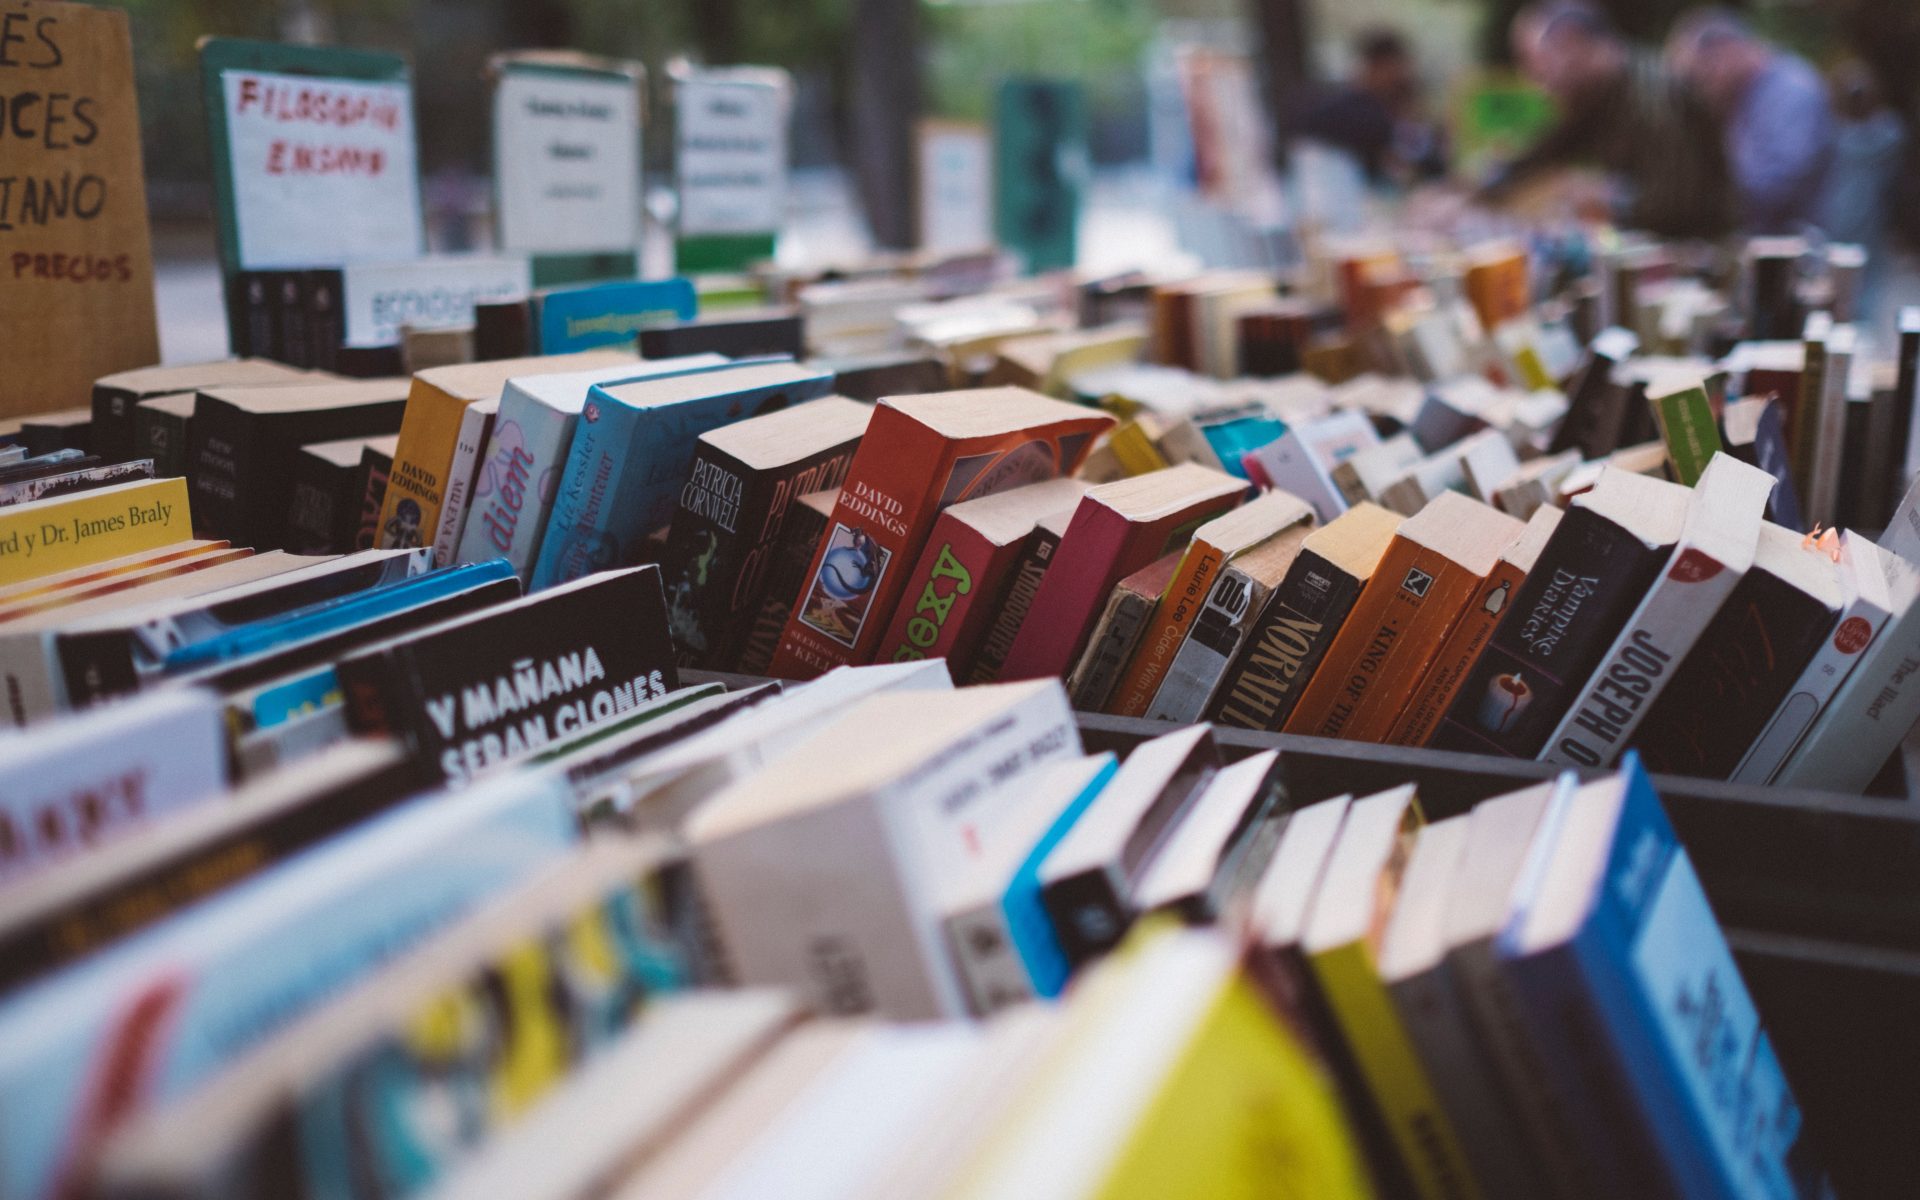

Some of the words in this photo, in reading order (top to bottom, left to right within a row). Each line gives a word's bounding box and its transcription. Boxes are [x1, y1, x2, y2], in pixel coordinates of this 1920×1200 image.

[0, 92, 99, 150] CES
[391, 471, 440, 505] EDDINGS
[402, 460, 437, 488] DAVID
[566, 432, 596, 501] Kessler
[691, 457, 743, 506] PATRICIA
[482, 446, 534, 552] diem
[681, 481, 740, 534] CORNWELL
[839, 490, 908, 537] EDDINGS
[855, 481, 904, 516] DAVID
[25, 533, 36, 557] y
[41, 523, 70, 546] Dr.
[73, 514, 126, 545] James
[128, 500, 172, 527] Braly
[1187, 555, 1216, 595] Laurie
[1173, 597, 1194, 622] Lee
[1155, 625, 1179, 661] Cider
[1231, 601, 1323, 718] NORAH
[1361, 626, 1397, 674] KING
[425, 692, 456, 739] Y
[462, 646, 605, 730] MAÑANA
[1137, 661, 1161, 692] With
[1346, 675, 1367, 701] OF
[1574, 629, 1674, 744] JOSEPH
[555, 669, 667, 738] CLONES
[1321, 701, 1352, 738] THE
